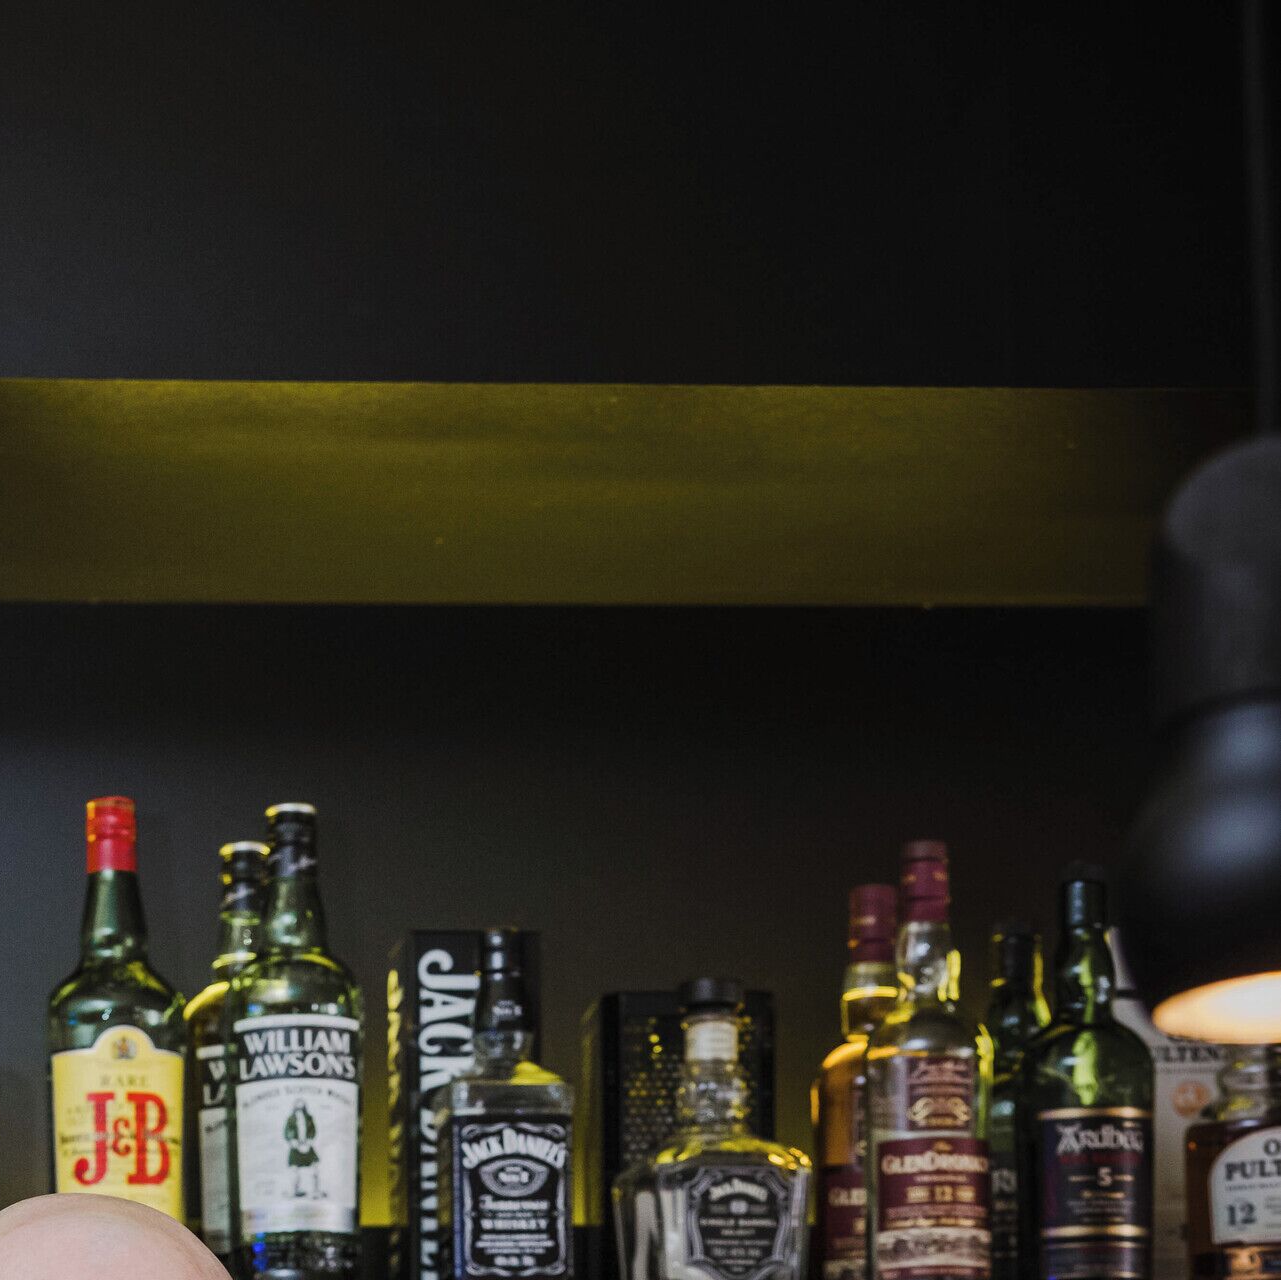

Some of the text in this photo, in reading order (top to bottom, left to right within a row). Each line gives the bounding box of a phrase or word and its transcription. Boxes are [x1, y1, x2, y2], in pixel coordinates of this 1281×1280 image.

[243, 1028, 352, 1055] WILLIAM
[239, 1053, 356, 1081] LAWSON'S
[73, 1090, 172, 1187] J&B
[1227, 1201, 1257, 1226] 12
